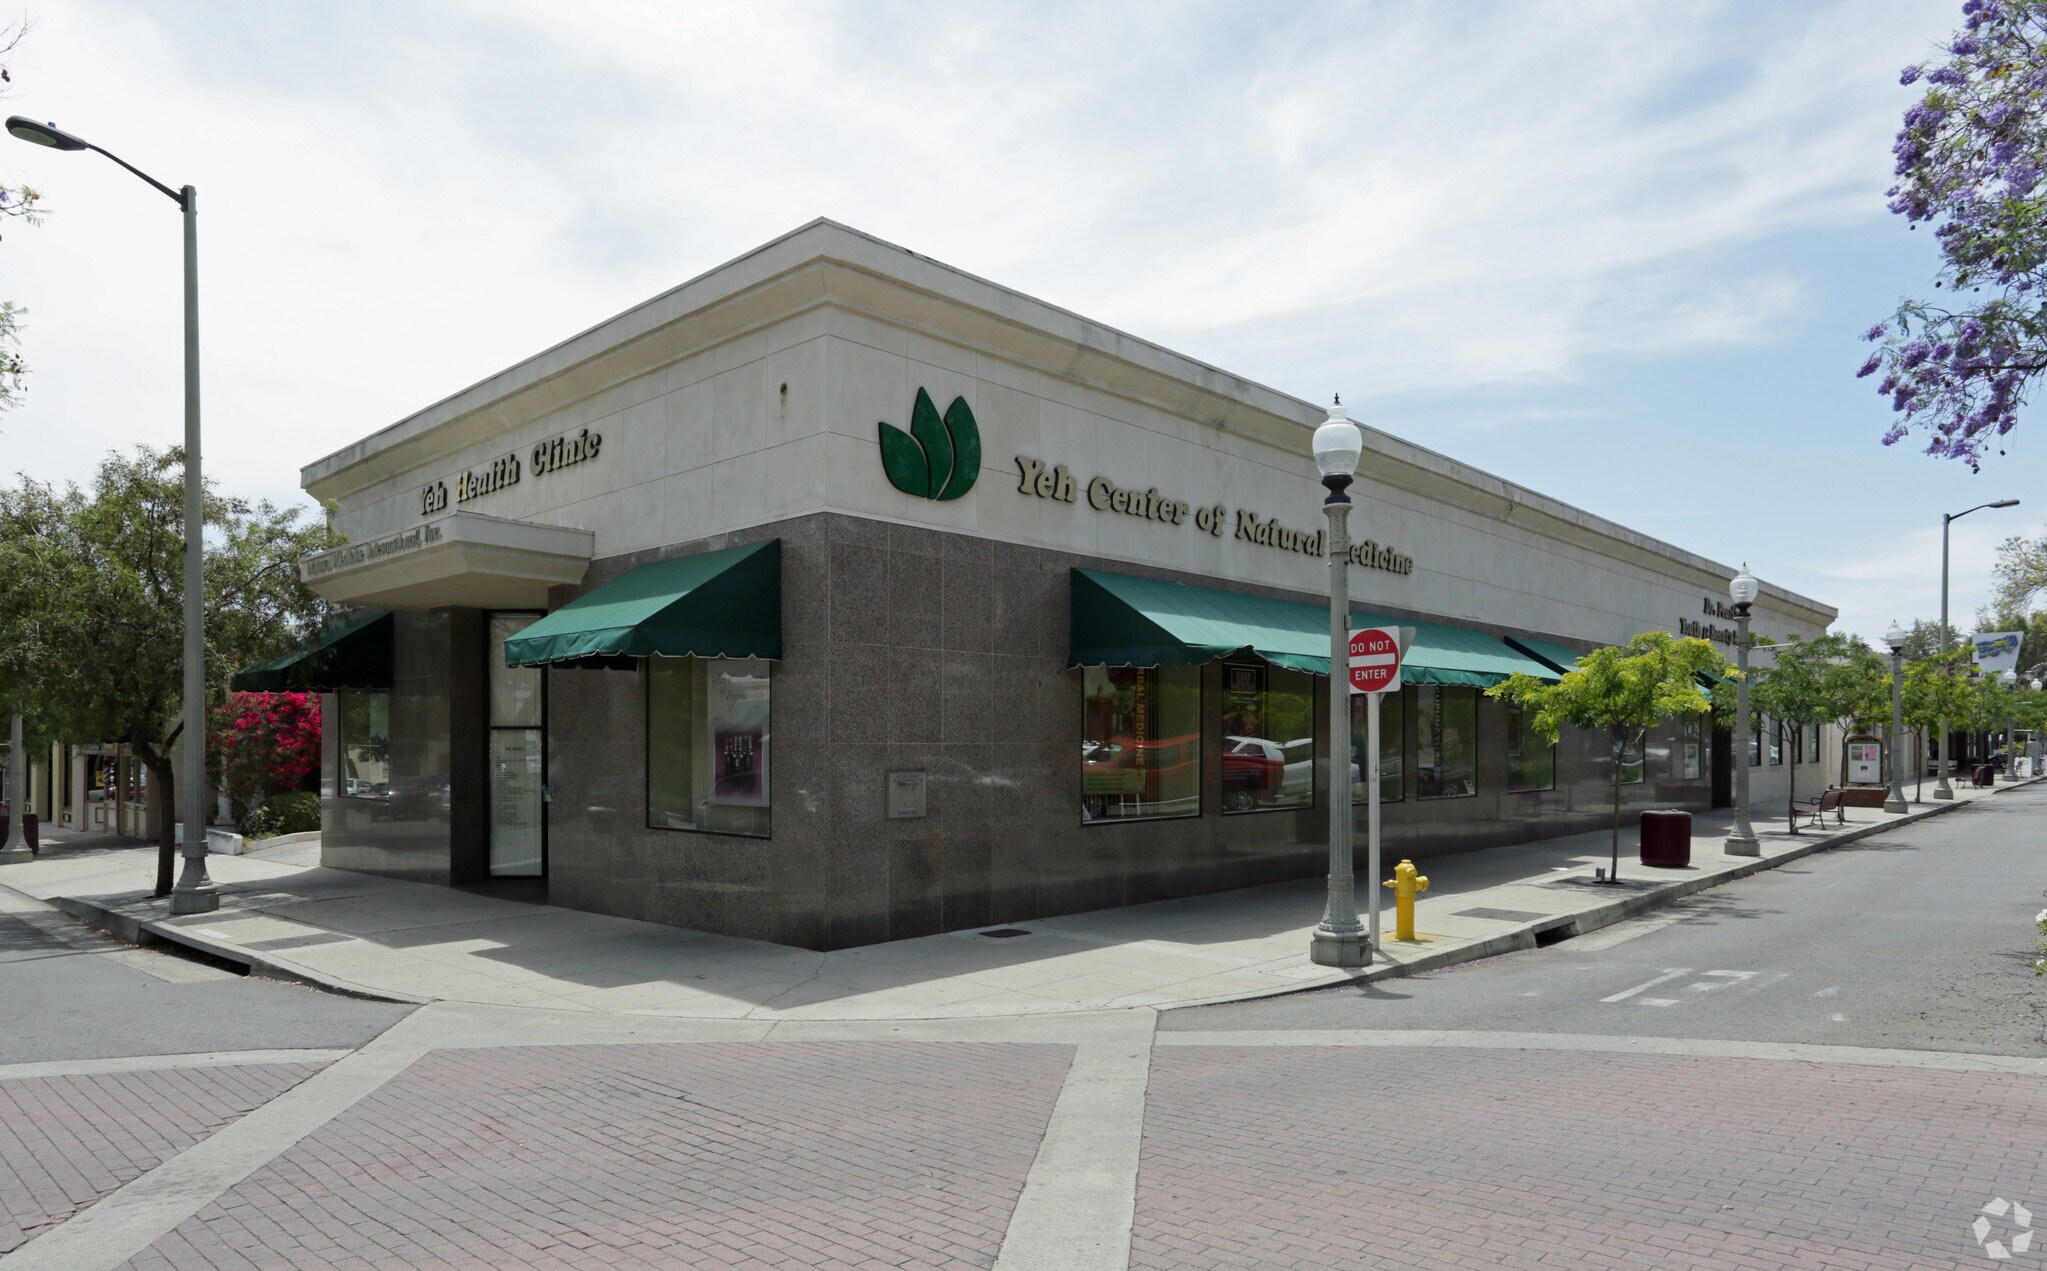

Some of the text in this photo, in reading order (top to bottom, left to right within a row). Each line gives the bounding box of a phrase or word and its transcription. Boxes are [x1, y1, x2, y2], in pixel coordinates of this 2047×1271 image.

[421, 428, 602, 515] Yeh Health Clinic
[1014, 456, 1413, 575] Yeh Center of Natural edicine
[1350, 640, 1390, 654] DO NOT
[1136, 667, 1145, 699] RBAL
[1355, 668, 1387, 681] ENTER
